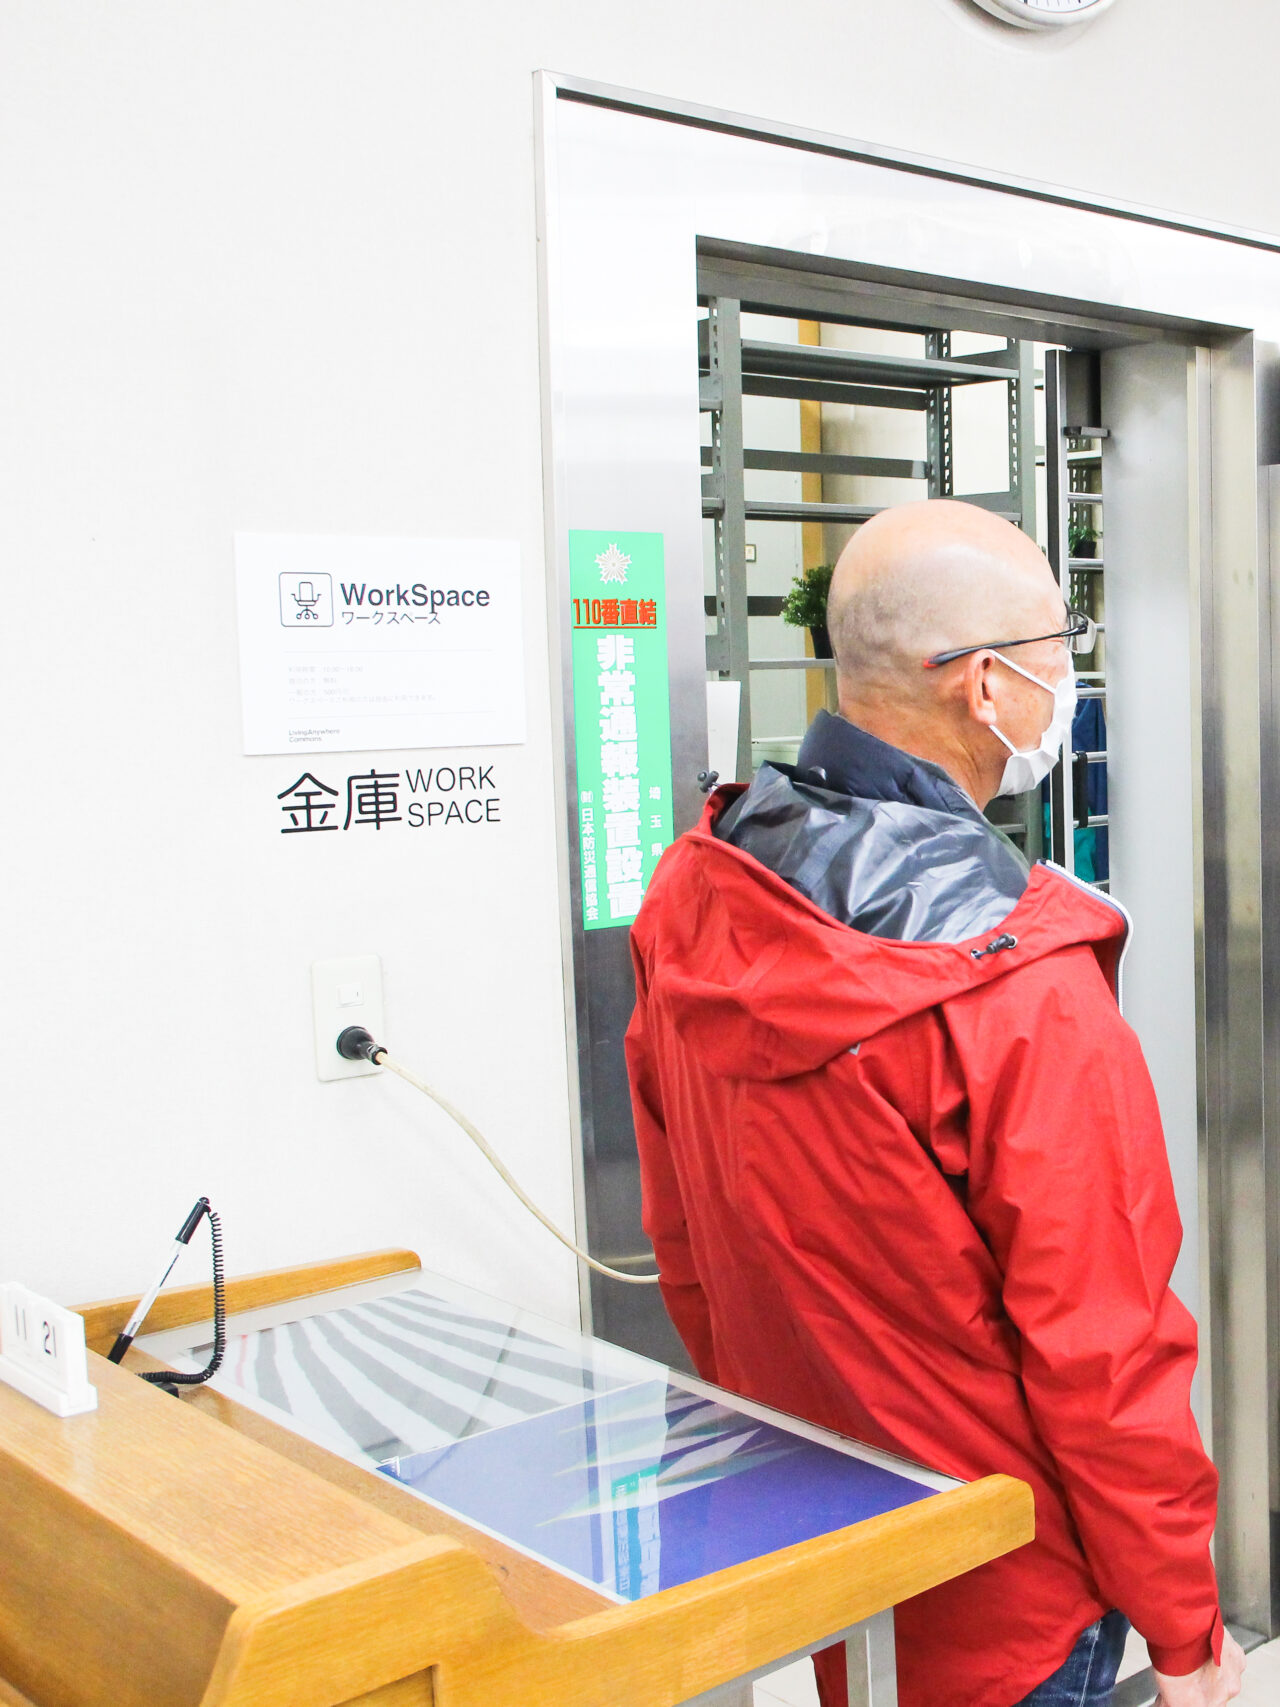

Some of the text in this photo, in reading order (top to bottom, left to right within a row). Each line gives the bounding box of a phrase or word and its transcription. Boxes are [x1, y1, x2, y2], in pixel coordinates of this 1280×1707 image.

[340, 583, 490, 613] WorkSpace
[573, 598, 657, 626] 110番直結
[341, 611, 440, 625] ワークスペース
[405, 765, 496, 793] WORK
[277, 769, 402, 834] 金庫
[408, 798, 501, 827] SPACE
[42, 1320, 57, 1358] 21
